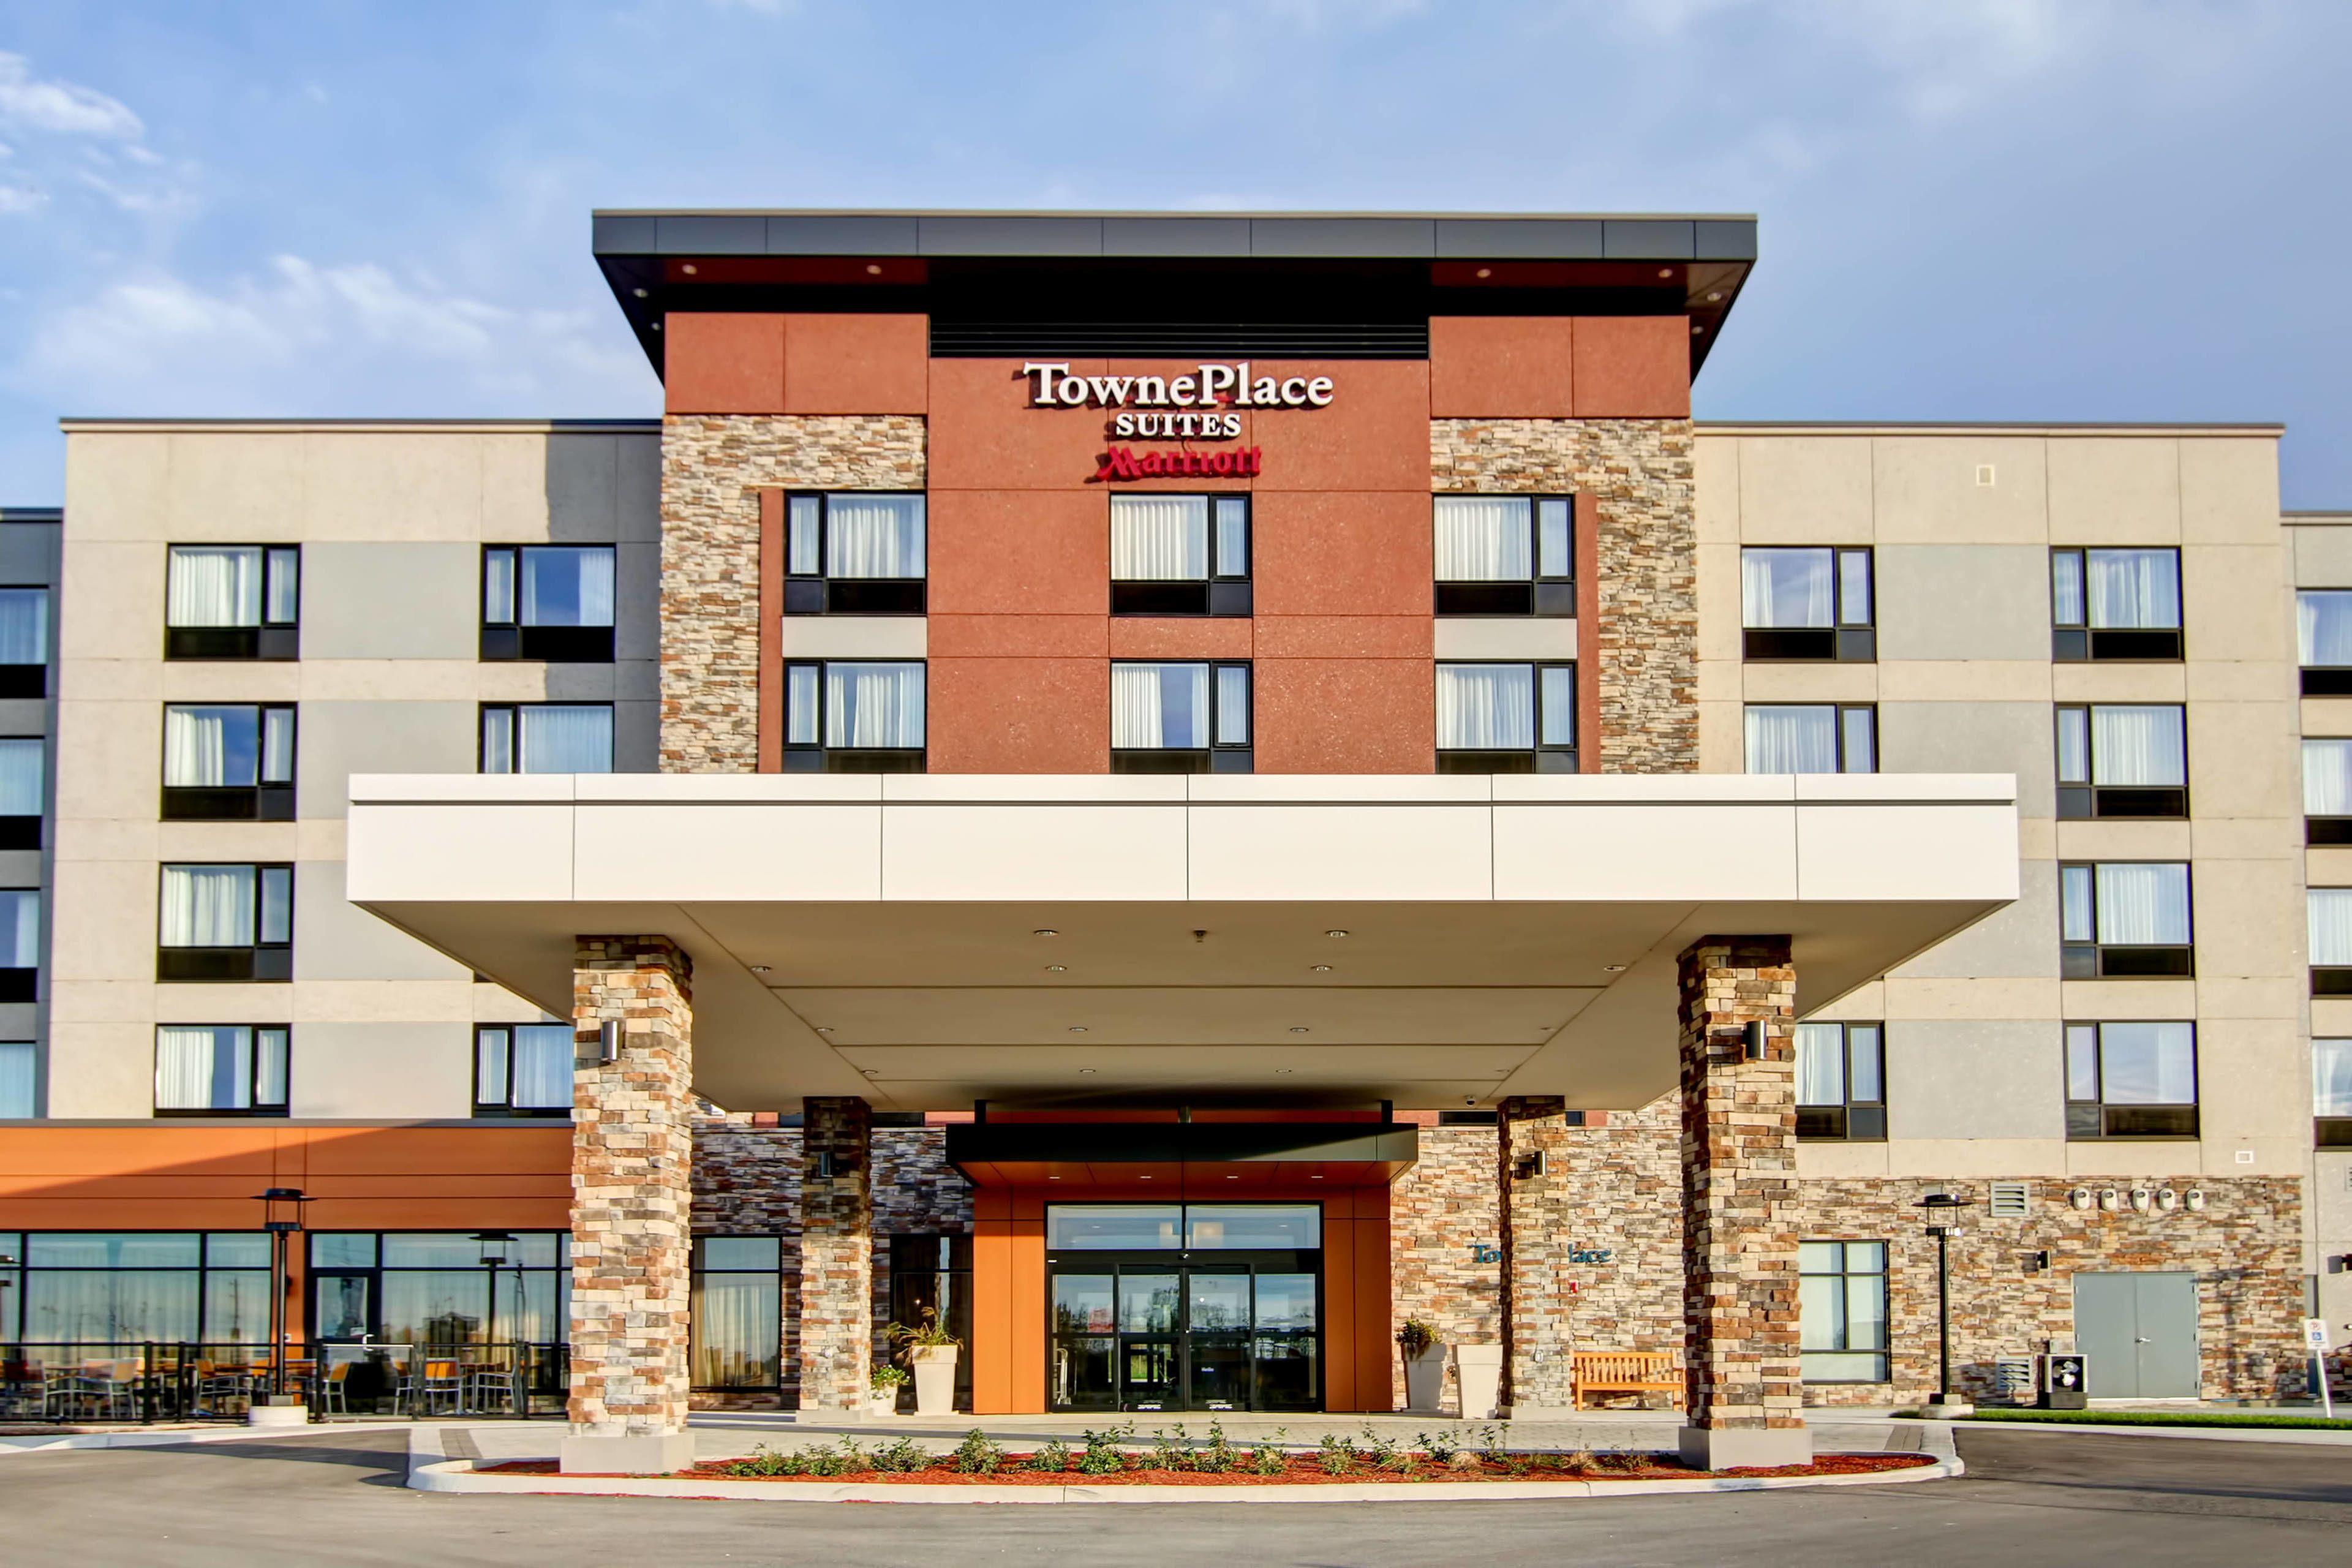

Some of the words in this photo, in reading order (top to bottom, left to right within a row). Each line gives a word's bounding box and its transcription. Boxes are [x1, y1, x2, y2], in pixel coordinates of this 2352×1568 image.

[1023, 362, 1333, 406] TownePlace
[1116, 413, 1241, 436] SUITES
[1096, 446, 1261, 478] Marriott
